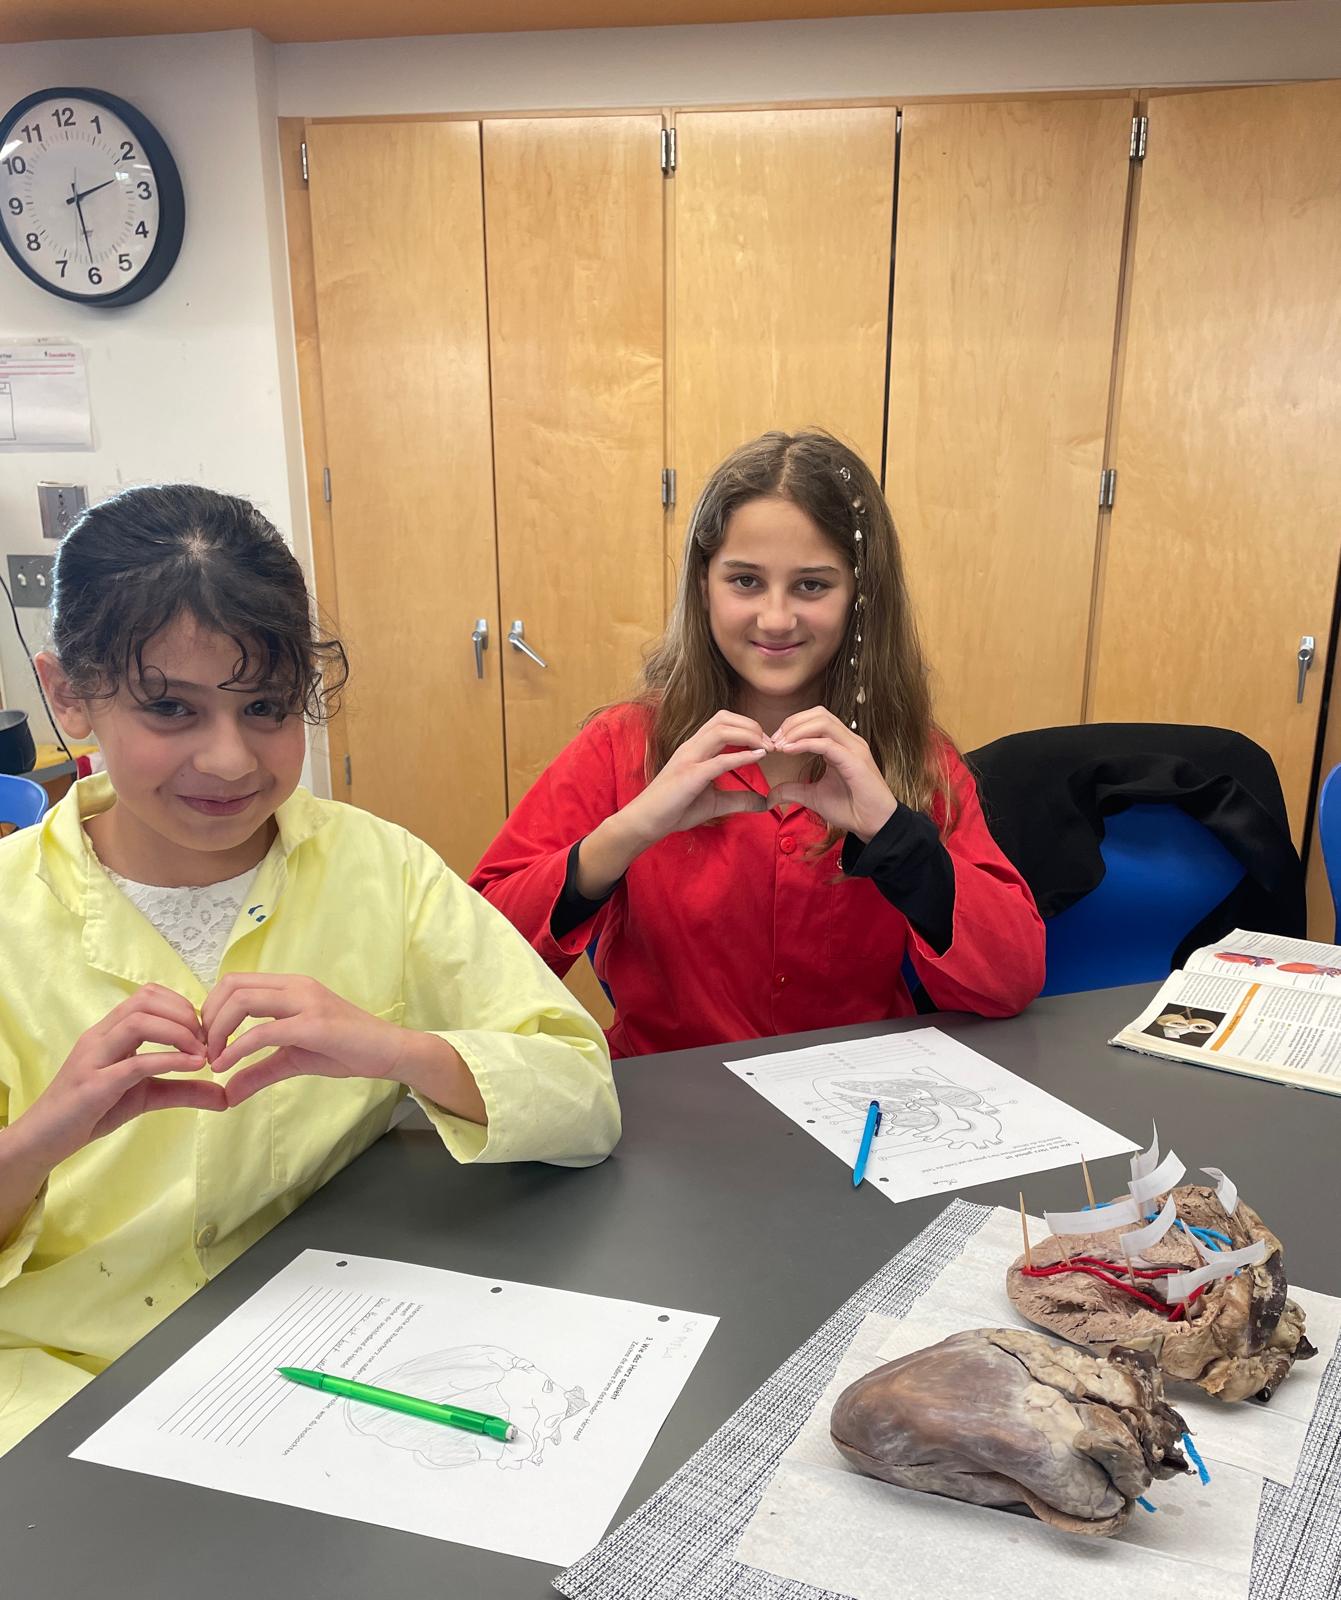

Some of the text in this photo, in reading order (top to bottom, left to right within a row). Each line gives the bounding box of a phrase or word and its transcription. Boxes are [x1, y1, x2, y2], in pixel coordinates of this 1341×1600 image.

[52, 108, 76, 127] 12
[91, 116, 102, 134] 1
[21, 124, 43, 143] 11
[120, 142, 135, 161] 2
[3, 156, 25, 175] 10
[137, 181, 151, 199] 3
[9, 198, 23, 215] 9
[135, 221, 149, 238] 4
[27, 233, 41, 251] 8
[55, 260, 67, 278] 7
[119, 254, 132, 271] 5
[88, 267, 102, 284] 6
[638, 1343, 650, 1353] Wie
[632, 1353, 642, 1363] das
[623, 1364, 637, 1377] Herz
[610, 1378, 627, 1400] aussieht
